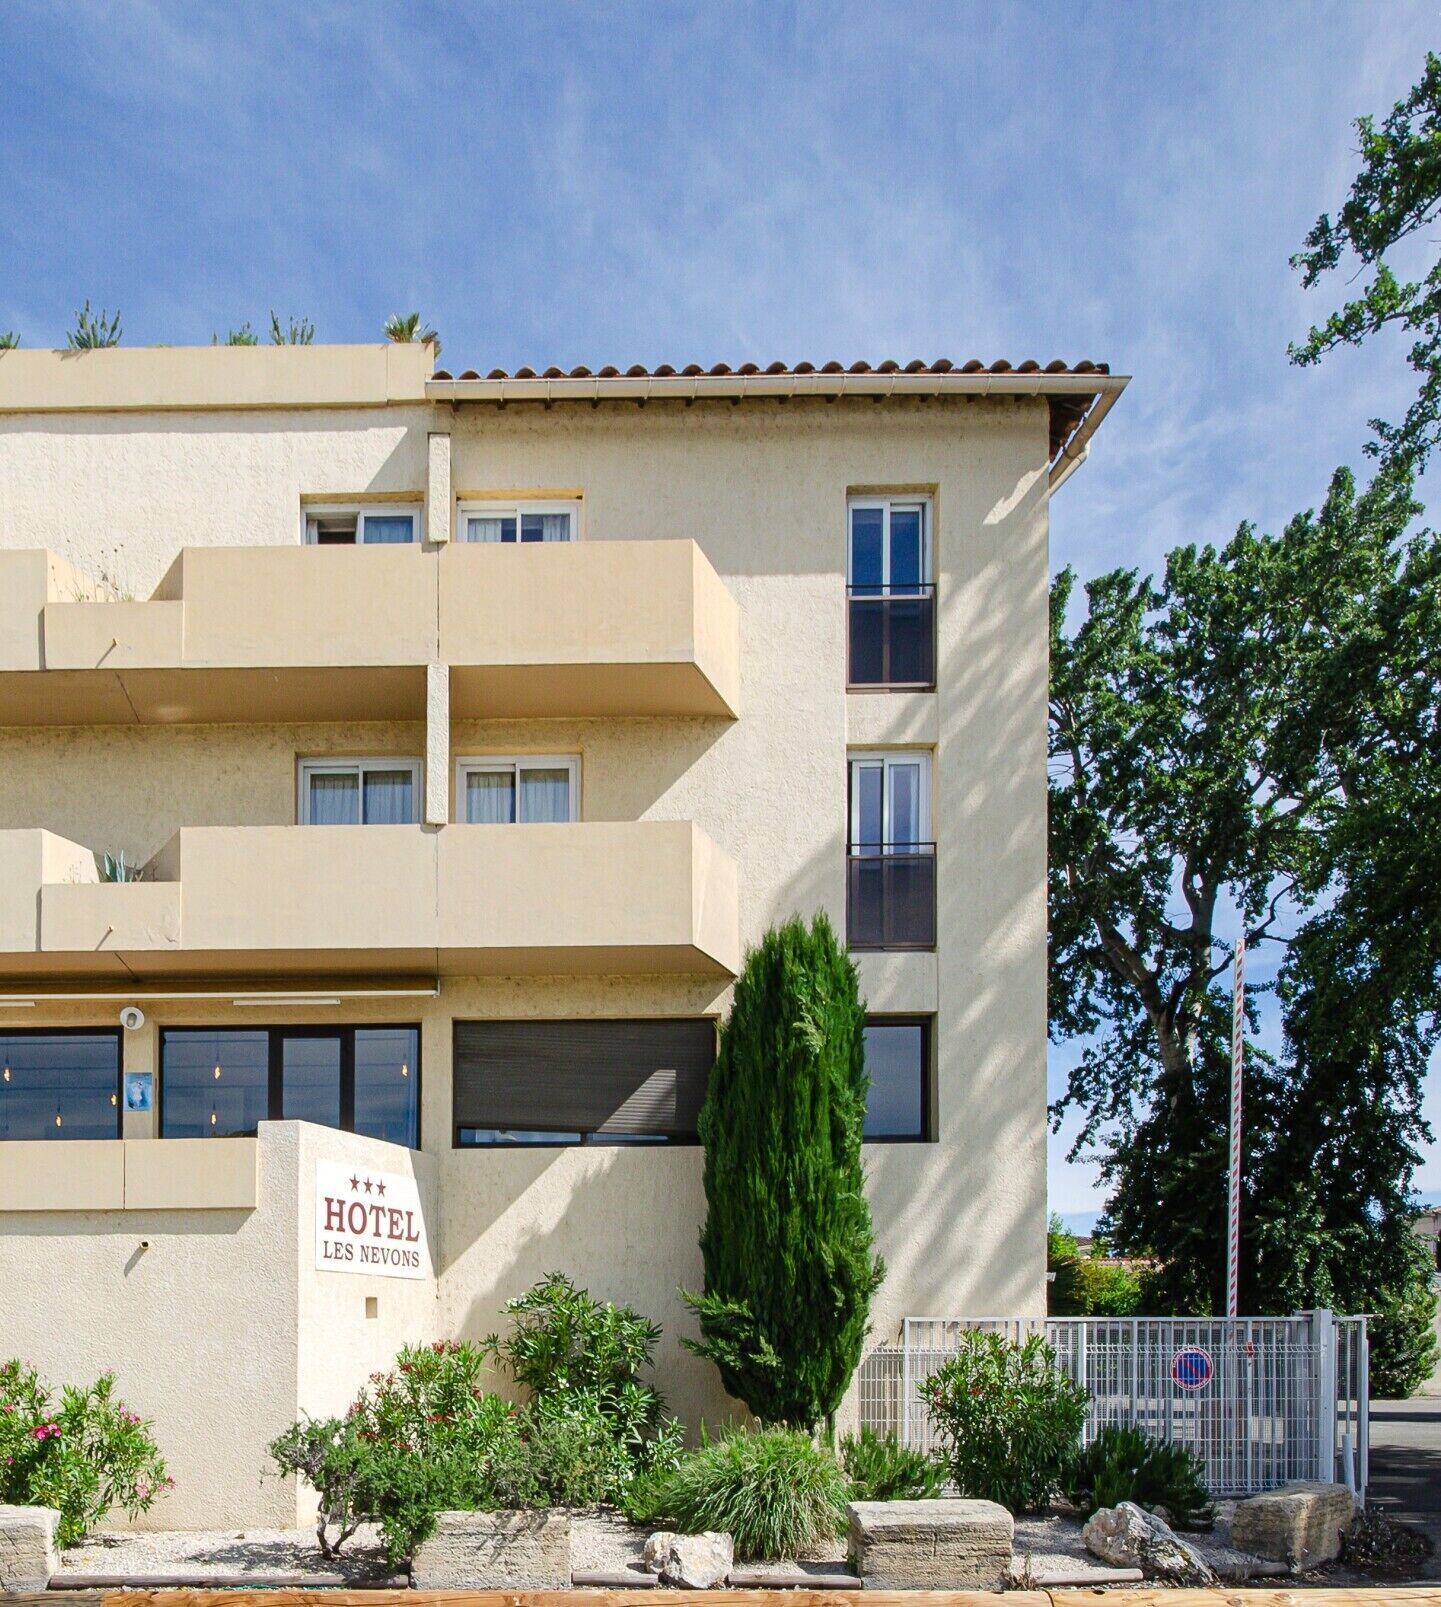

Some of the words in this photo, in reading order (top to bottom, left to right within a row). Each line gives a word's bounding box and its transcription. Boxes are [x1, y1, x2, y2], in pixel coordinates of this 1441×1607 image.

[324, 1197, 420, 1242] HOTEL
[323, 1240, 354, 1261] LES
[360, 1245, 420, 1268] NEVONS
